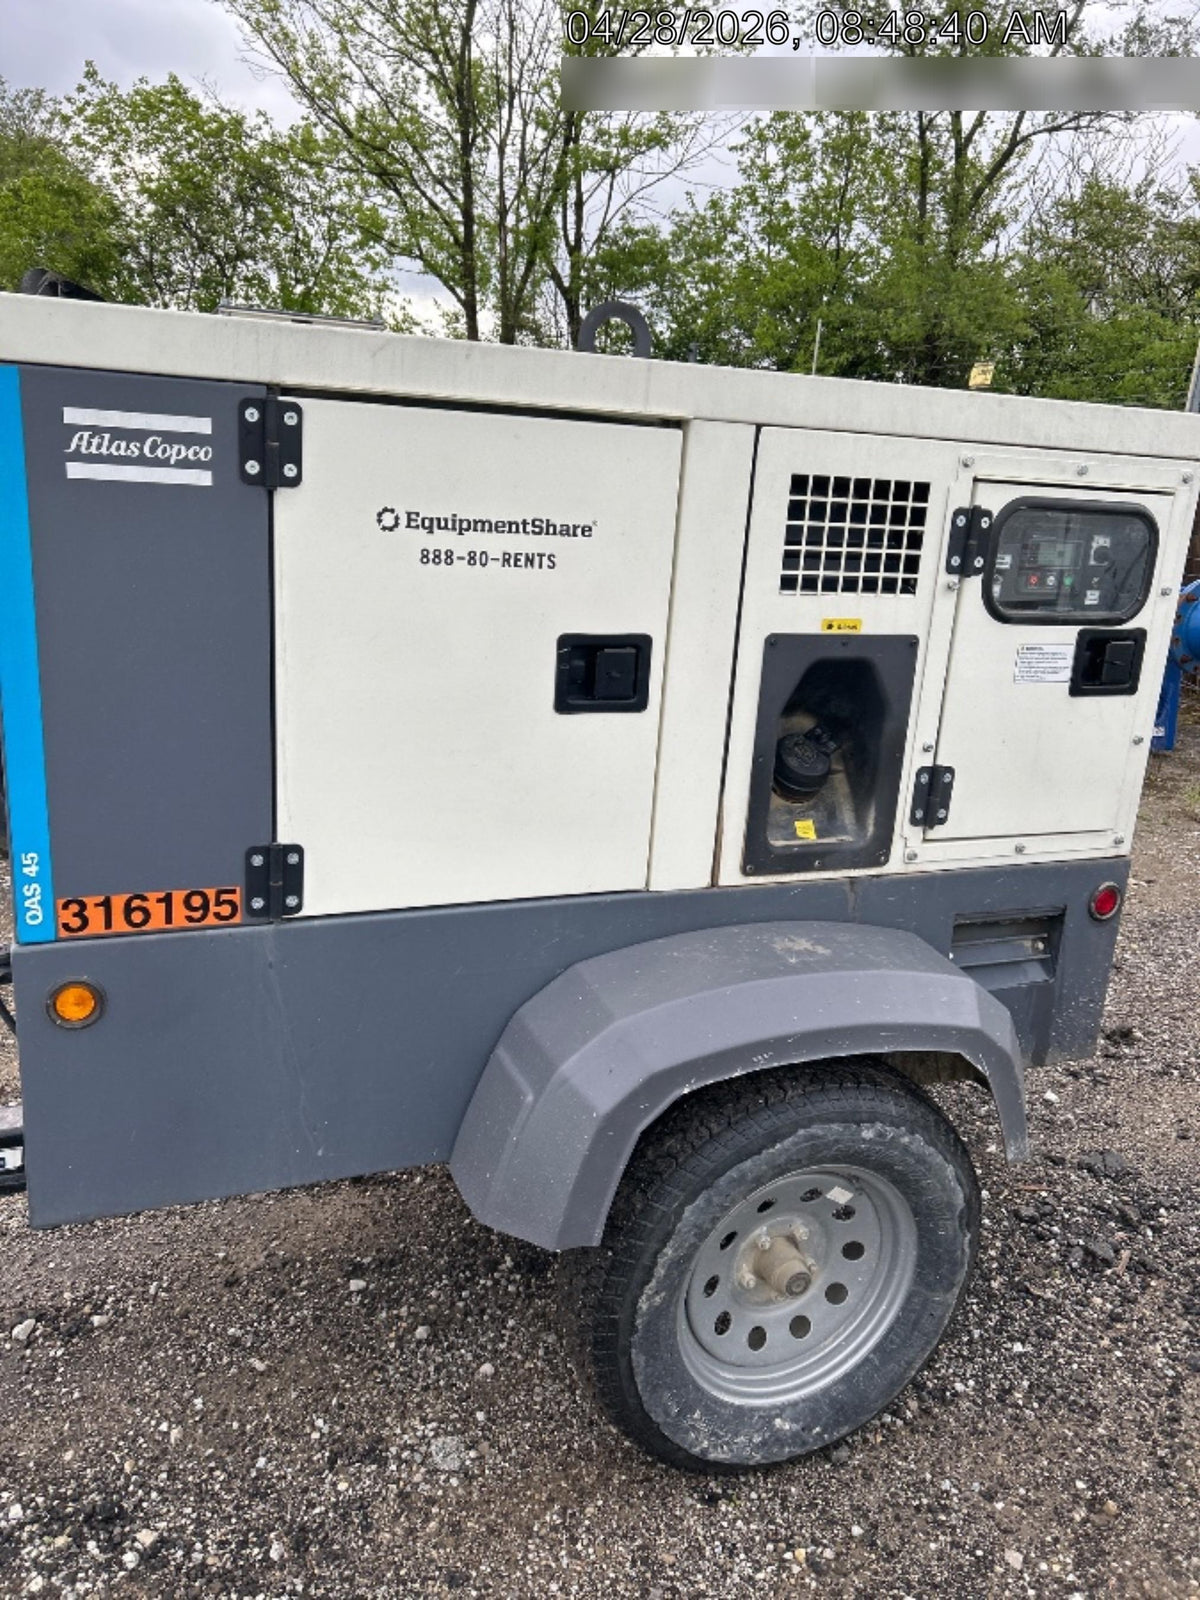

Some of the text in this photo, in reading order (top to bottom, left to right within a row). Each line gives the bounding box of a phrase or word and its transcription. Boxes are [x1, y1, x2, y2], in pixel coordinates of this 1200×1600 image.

[64, 431, 213, 464] Atlas Copco
[404, 510, 593, 537] EquipmentShare
[419, 548, 557, 570] 888-80-RENTS
[21, 852, 40, 878] 45
[60, 888, 239, 934] 316195
